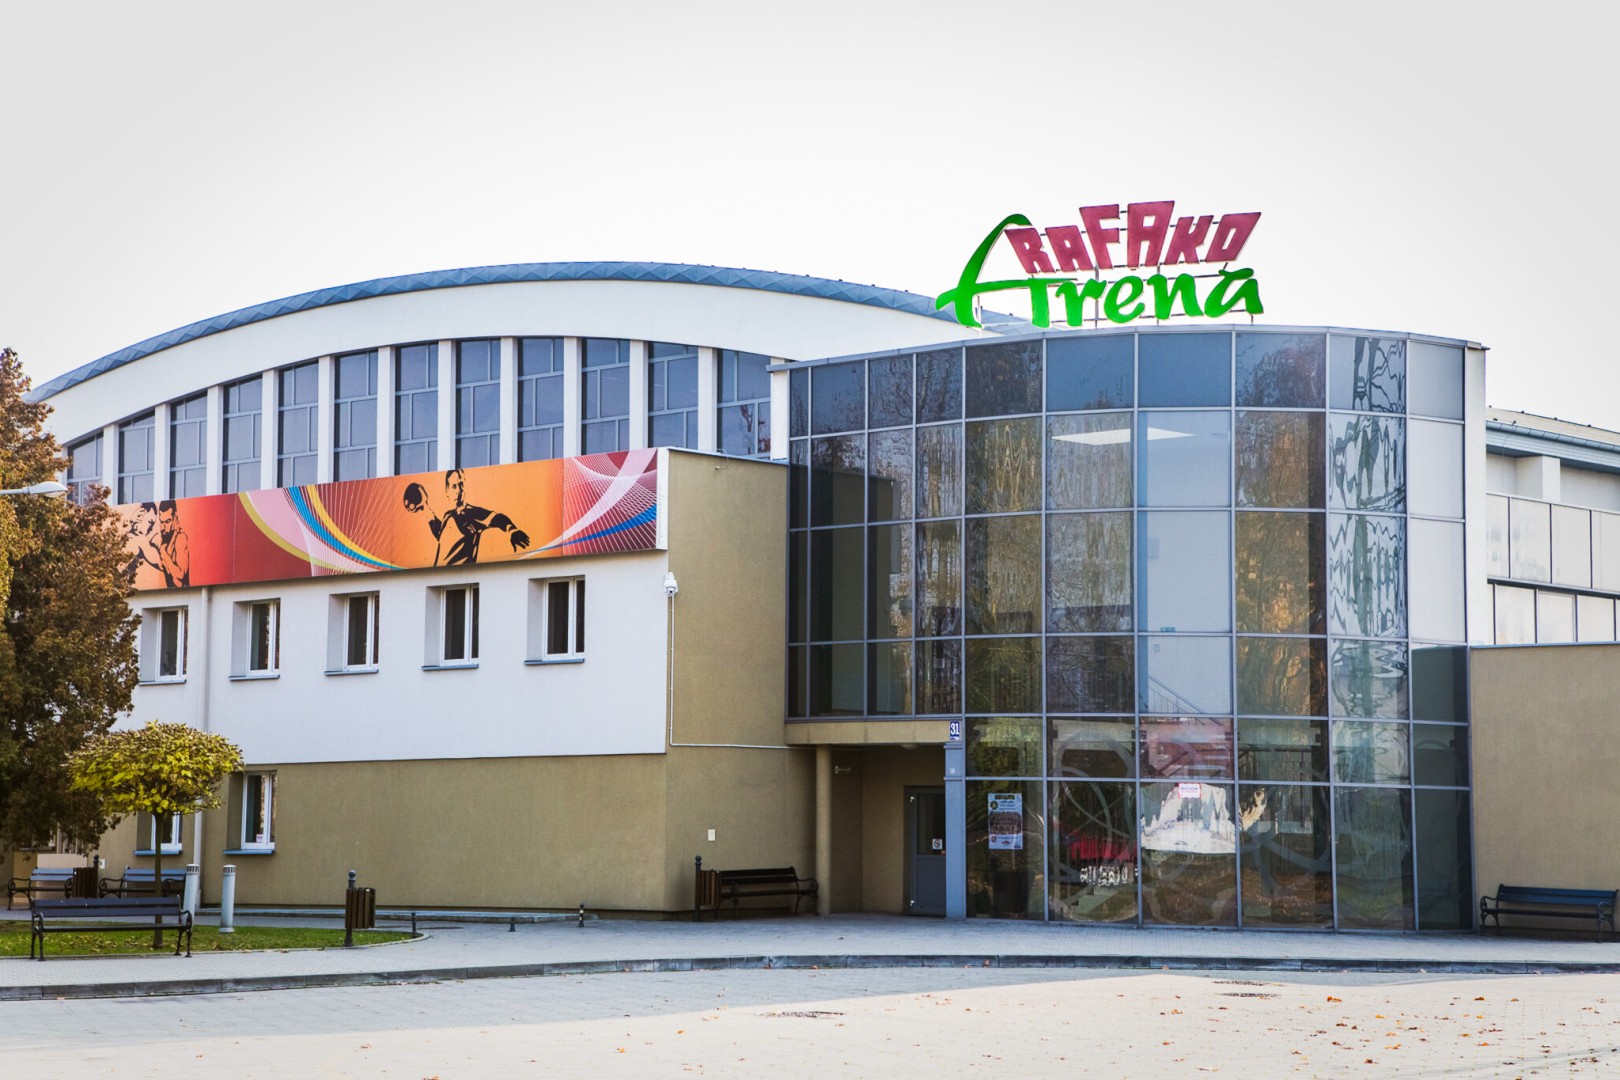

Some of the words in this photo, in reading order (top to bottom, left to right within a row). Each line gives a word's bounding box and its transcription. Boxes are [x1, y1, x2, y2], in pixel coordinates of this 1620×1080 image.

[936, 213, 1264, 328] Arena
[1004, 201, 1262, 274] RAFAKO
[950, 722, 960, 735] 31
